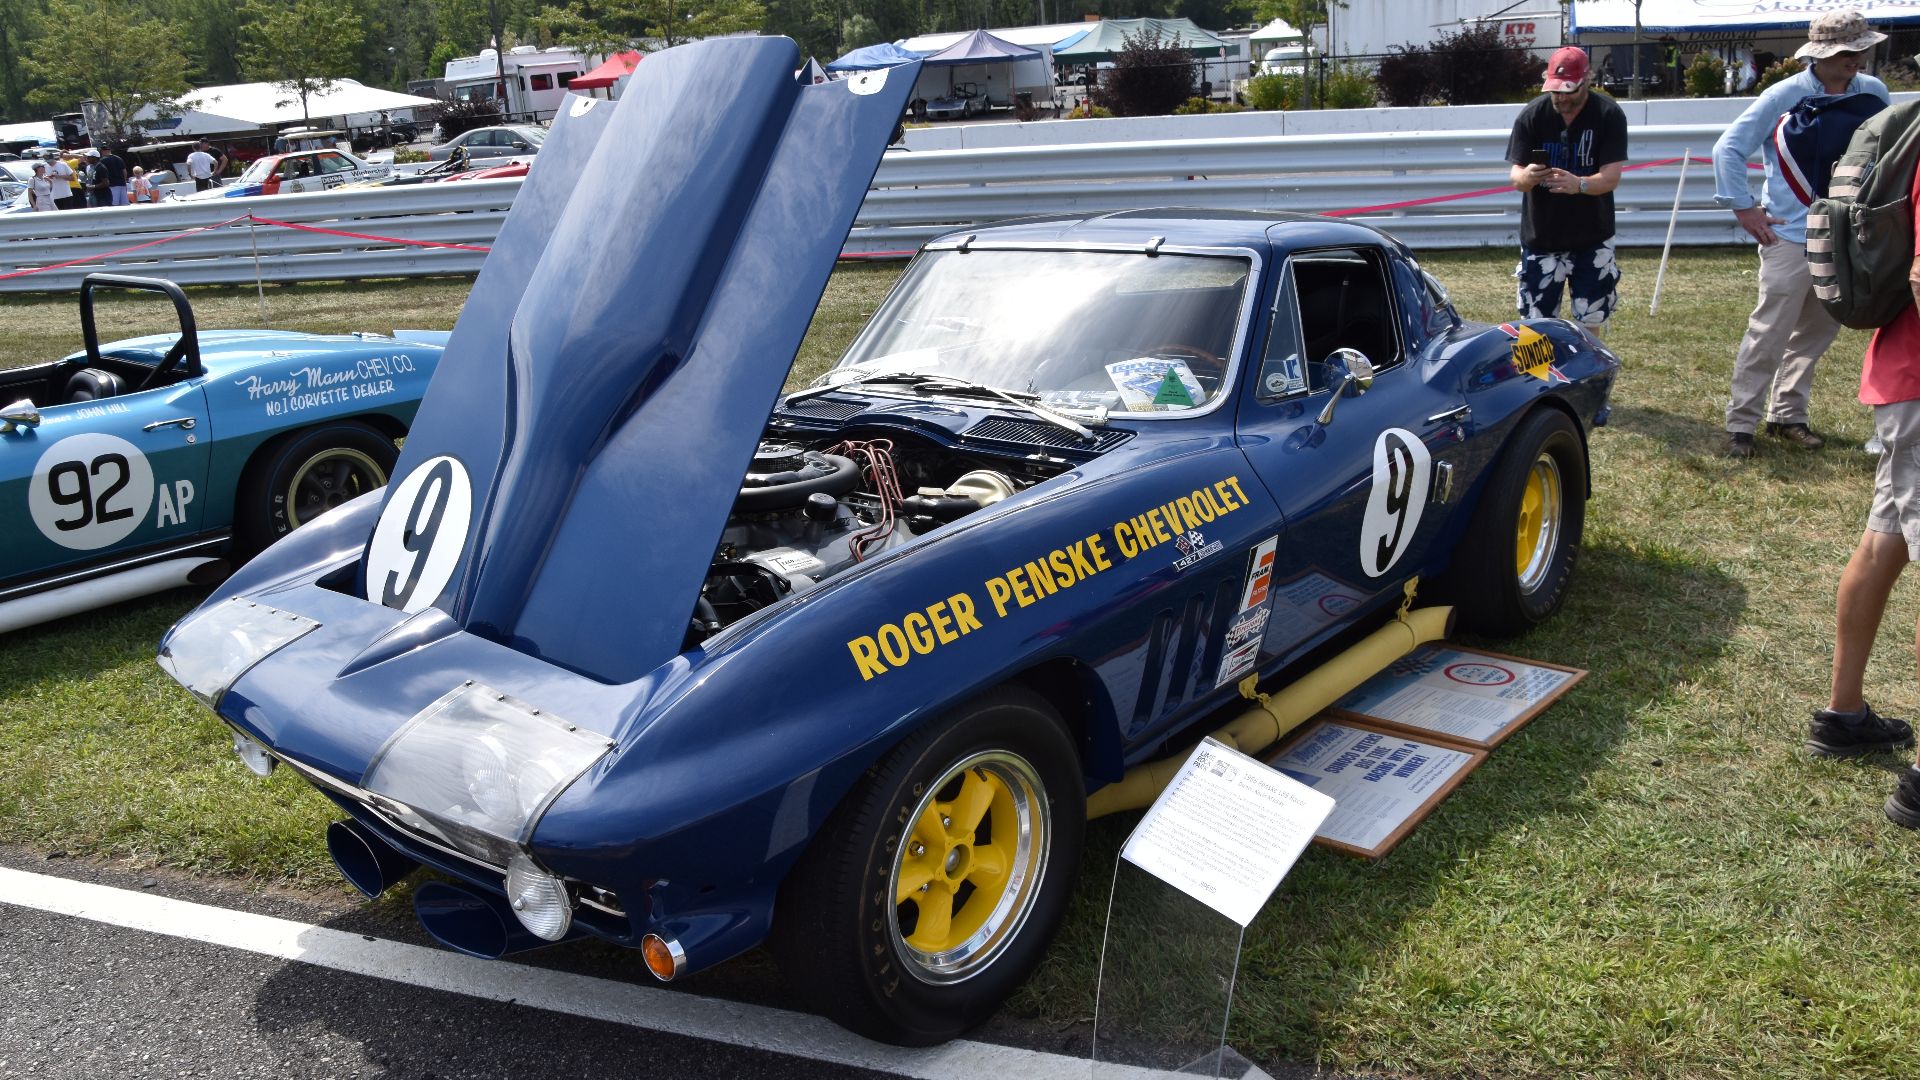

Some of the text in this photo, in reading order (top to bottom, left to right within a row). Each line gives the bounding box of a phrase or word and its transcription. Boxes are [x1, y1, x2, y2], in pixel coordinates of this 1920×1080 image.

[1505, 22, 1536, 35] KTR
[1577, 129, 1594, 167] 42
[321, 175, 344, 184] DEKRA
[1511, 335, 1554, 373] SUNOCO
[235, 375, 301, 400] Harry
[290, 367, 358, 388] Mann
[290, 389, 349, 411] CORVETTE
[352, 379, 395, 399] DEALER
[75, 405, 106, 420] JOHN
[106, 402, 131, 414] HILL
[48, 453, 134, 531] 92
[157, 479, 194, 528] AP
[1375, 432, 1415, 573] 9
[382, 459, 453, 611] 9
[1179, 553, 1197, 567] 427
[1251, 566, 1270, 580] FRAM
[847, 475, 1250, 681] ROGER PENSKE CHEVROLET
[1323, 752, 1361, 774] SUNOCO
[1351, 733, 1384, 753] ENTERS
[1362, 761, 1397, 782] RACING
[1386, 747, 1414, 761] WITH
[1392, 754, 1430, 778] WINNER!
